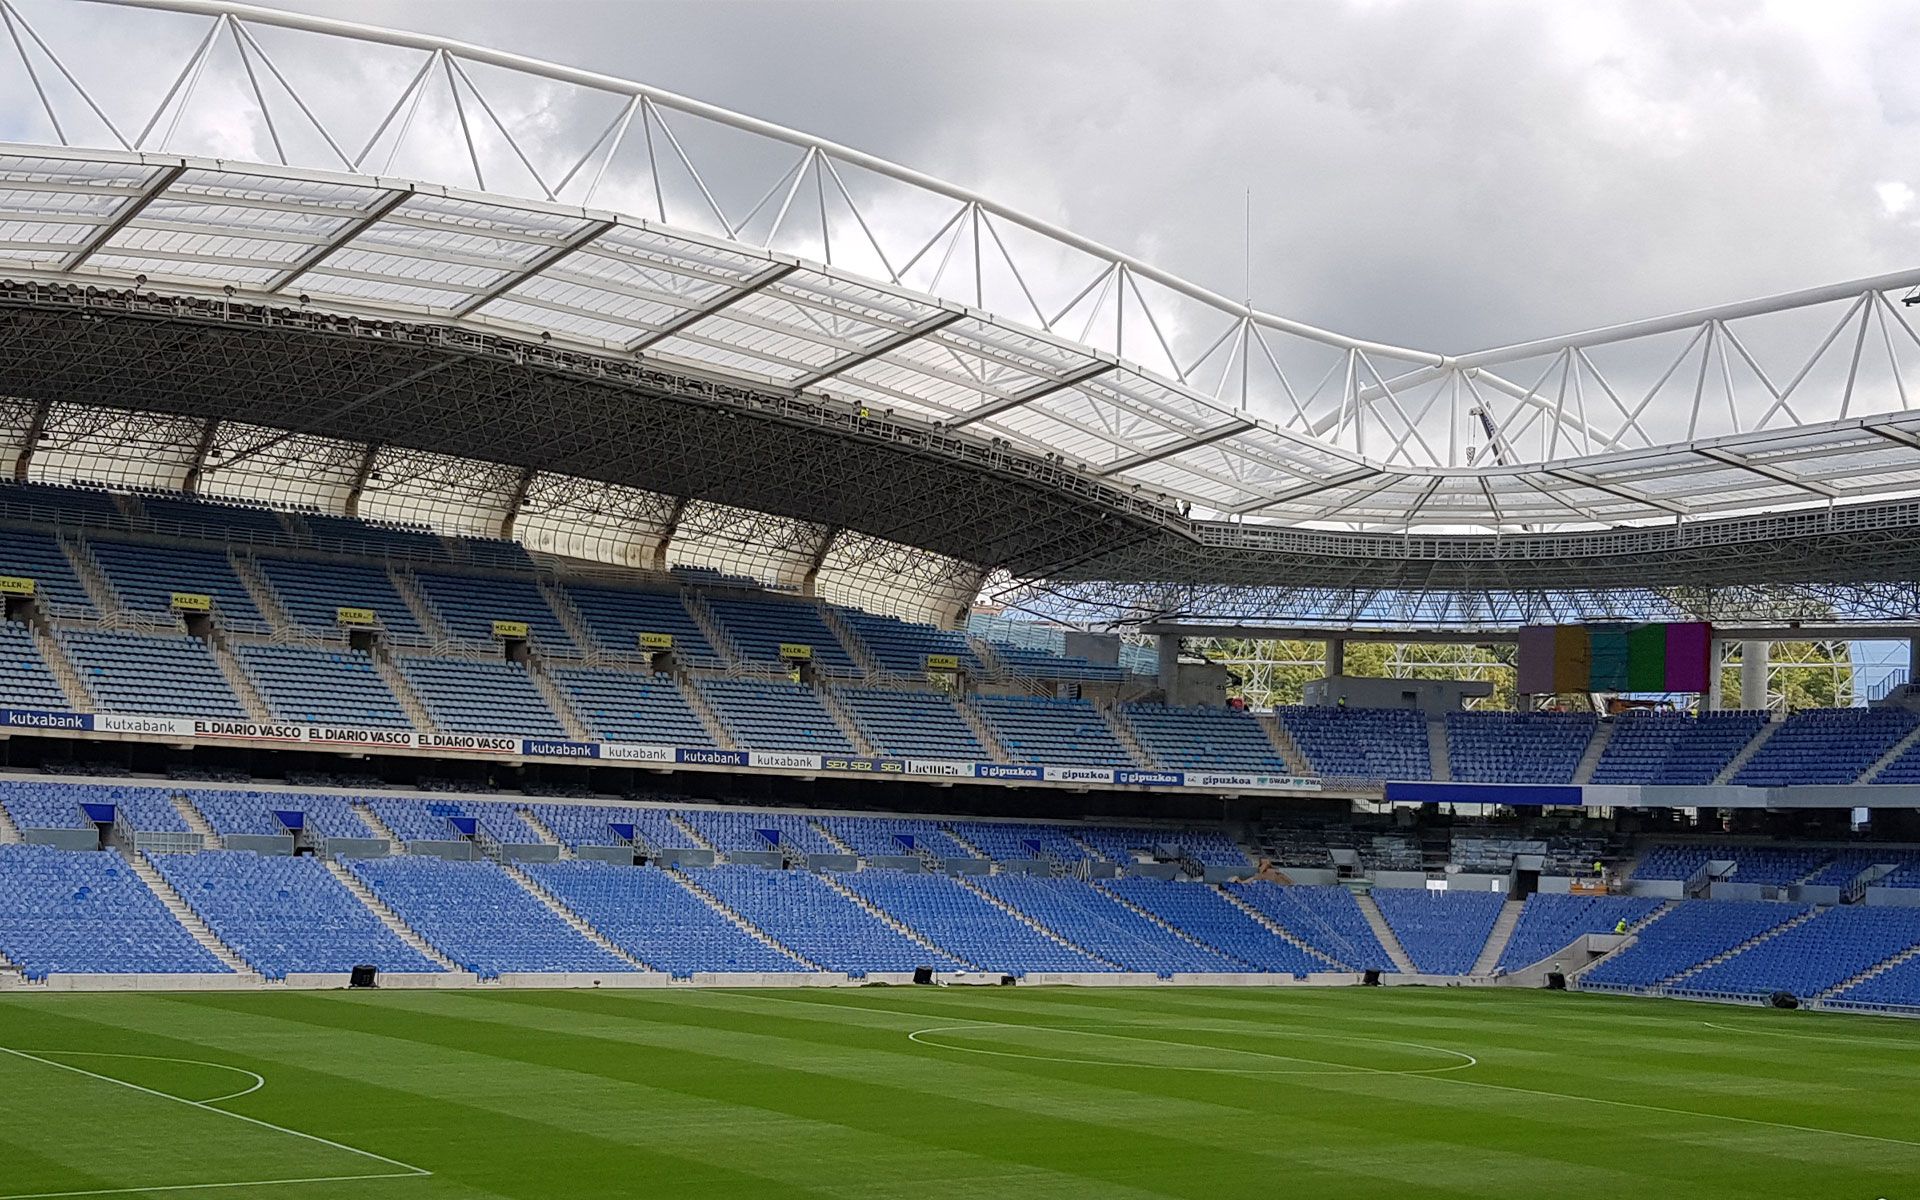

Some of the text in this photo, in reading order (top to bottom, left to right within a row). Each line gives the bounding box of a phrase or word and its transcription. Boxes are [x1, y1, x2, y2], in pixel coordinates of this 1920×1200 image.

[9, 711, 83, 728] kutxabank
[105, 717, 176, 733] kutxabank
[194, 721, 301, 738] EL DIARIO VASCO
[308, 728, 411, 744] EL DIARIO VASCO
[418, 734, 515, 750] EL DIARIO VASCO
[531, 742, 591, 756] kutxabank
[609, 746, 667, 760] kutxabank
[683, 750, 741, 764] kutxabank
[757, 755, 813, 768] kutxabank
[826, 761, 848, 769] SER
[850, 762, 872, 771] SER
[880, 763, 902, 772] SER
[989, 766, 1038, 777] gipuzkoa
[1061, 769, 1110, 780] gipuzkoa
[1129, 772, 1178, 783] gipuzkoa
[1202, 775, 1251, 785] gipuzkoa
[1269, 777, 1291, 785] SWAP
